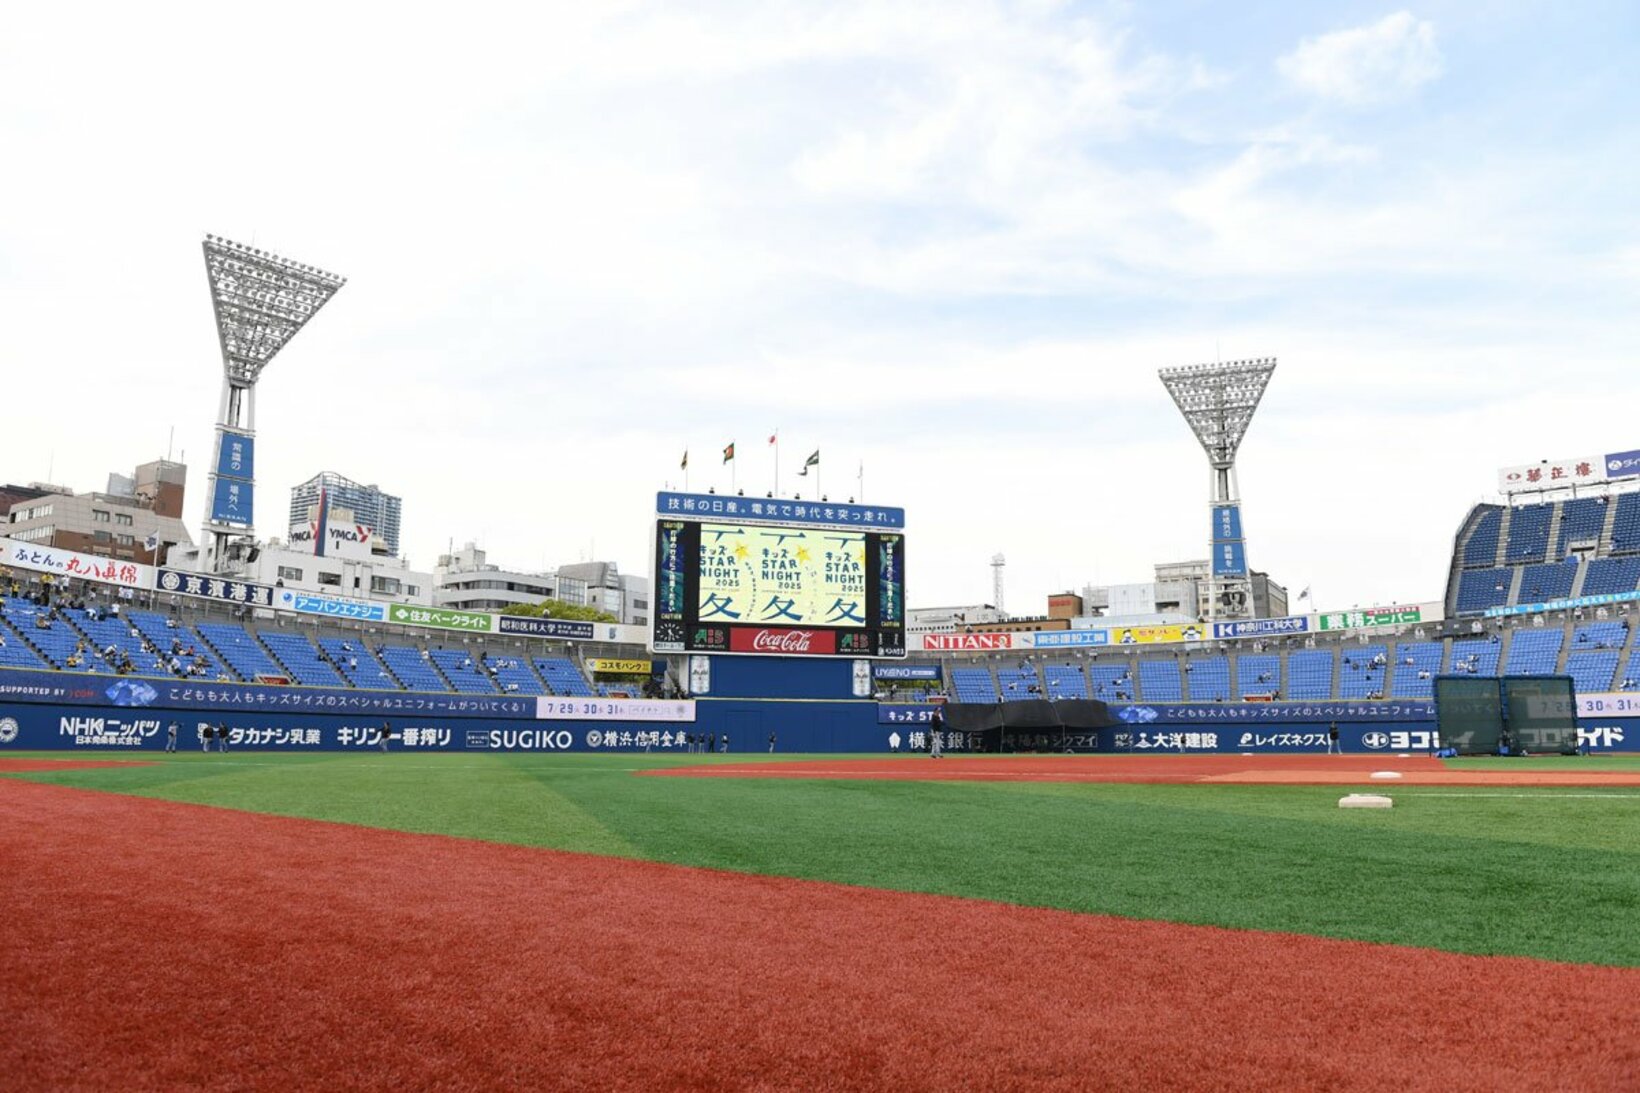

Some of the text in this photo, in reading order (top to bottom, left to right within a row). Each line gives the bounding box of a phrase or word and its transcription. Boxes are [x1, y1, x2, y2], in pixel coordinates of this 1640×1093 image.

[291, 531, 311, 542] YMCA
[330, 528, 357, 541] YMCA
[700, 556, 735, 566] STAR
[762, 559, 797, 570] STAR
[825, 562, 859, 573] STAR
[700, 568, 739, 578] NIGHT
[762, 571, 801, 581] NIGHT
[825, 574, 864, 584] NIGHT
[716, 579, 739, 587] 2025
[297, 598, 382, 617] アーバンエナジー
[410, 610, 486, 628] 住友ベークライト
[1327, 611, 1415, 630] 業務スーパー
[753, 630, 813, 651] Coca-Cola
[924, 634, 992, 649] NITTAN
[888, 711, 914, 721] キッズ
[229, 728, 321, 745] タカナシ乳業
[337, 727, 451, 746] キリン一番搾り
[490, 730, 573, 748] SUGIKO
[1153, 732, 1218, 749] 大洋建設
